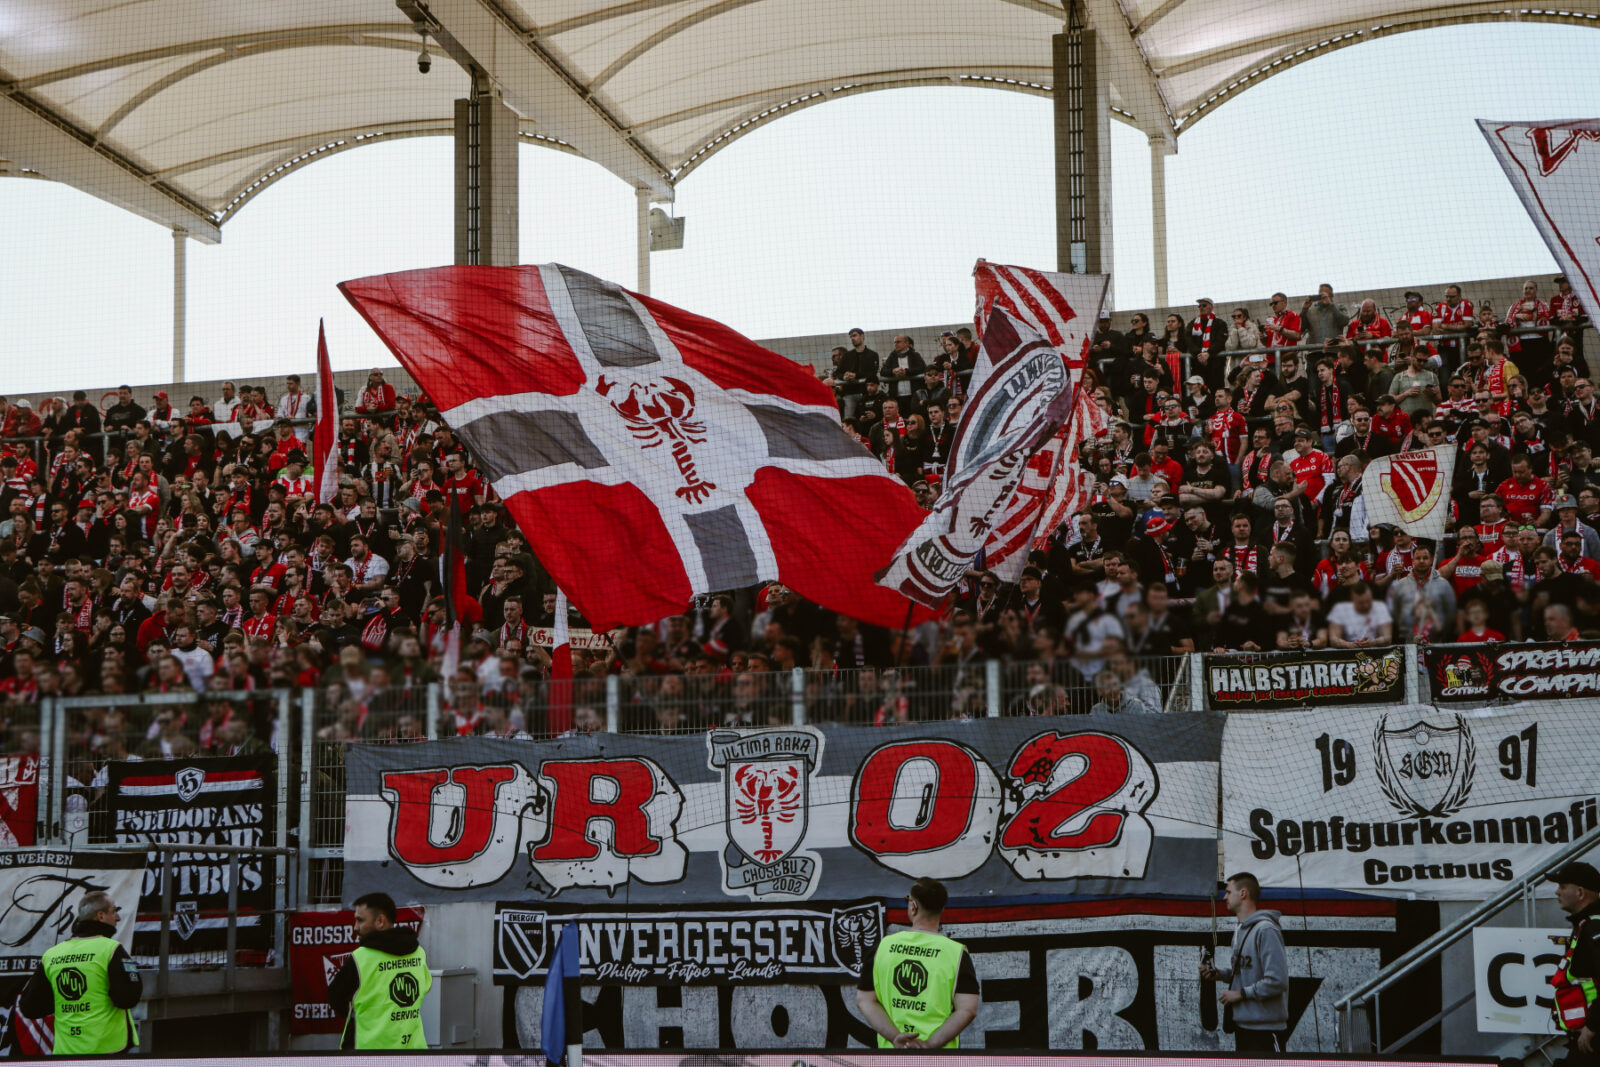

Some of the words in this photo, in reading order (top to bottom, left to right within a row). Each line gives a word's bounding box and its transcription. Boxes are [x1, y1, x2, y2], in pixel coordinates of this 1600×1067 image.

[1212, 662, 1358, 693] HALBSTARKE
[722, 737, 771, 761] ULTIMA
[775, 736, 811, 752] RAKA
[1315, 732, 1356, 793] 19
[115, 803, 264, 831] PSEUDOFANS
[17, 853, 73, 866] WEHREN
[1363, 857, 1514, 885] Cottbus
[140, 861, 263, 897] OTTBUS
[772, 878, 802, 893] 2002
[889, 943, 941, 959] SICHERHEIT
[12, 959, 26, 970] IN
[49, 953, 96, 966] SICHERHEIT
[378, 957, 422, 972] SICHERHEIT
[61, 1002, 91, 1013] SERVICE
[891, 997, 927, 1012] SERVICE
[70, 1026, 82, 1035] 55
